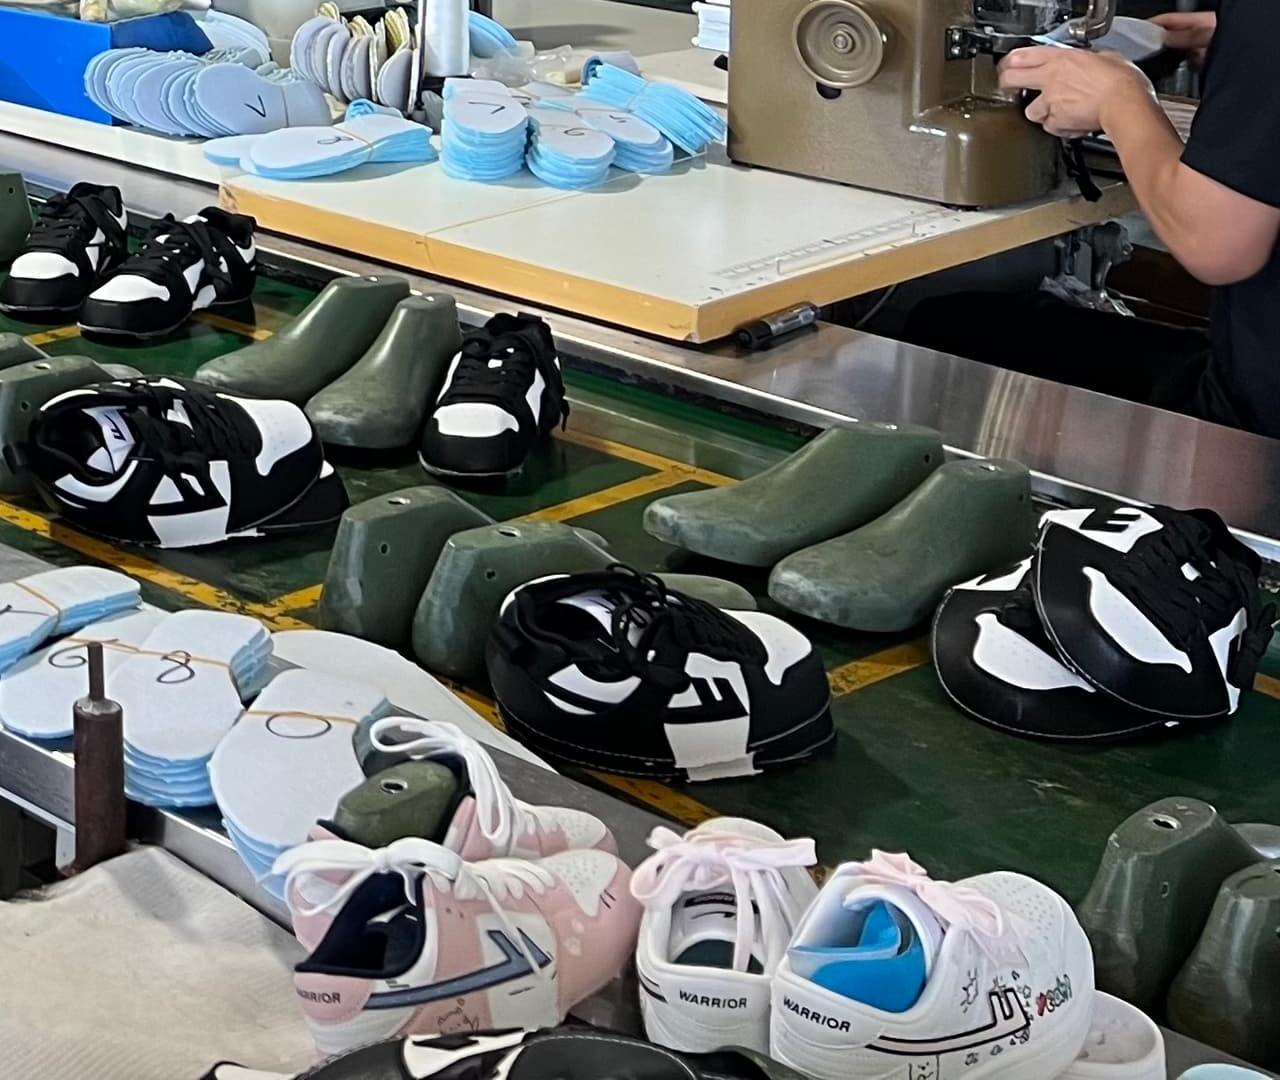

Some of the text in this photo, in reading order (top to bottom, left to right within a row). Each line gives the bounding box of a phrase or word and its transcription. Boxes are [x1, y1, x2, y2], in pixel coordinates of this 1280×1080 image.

[155, 650, 196, 685] 8
[678, 989, 748, 1010] WARRIOR
[782, 995, 852, 1034] WARRIOR
